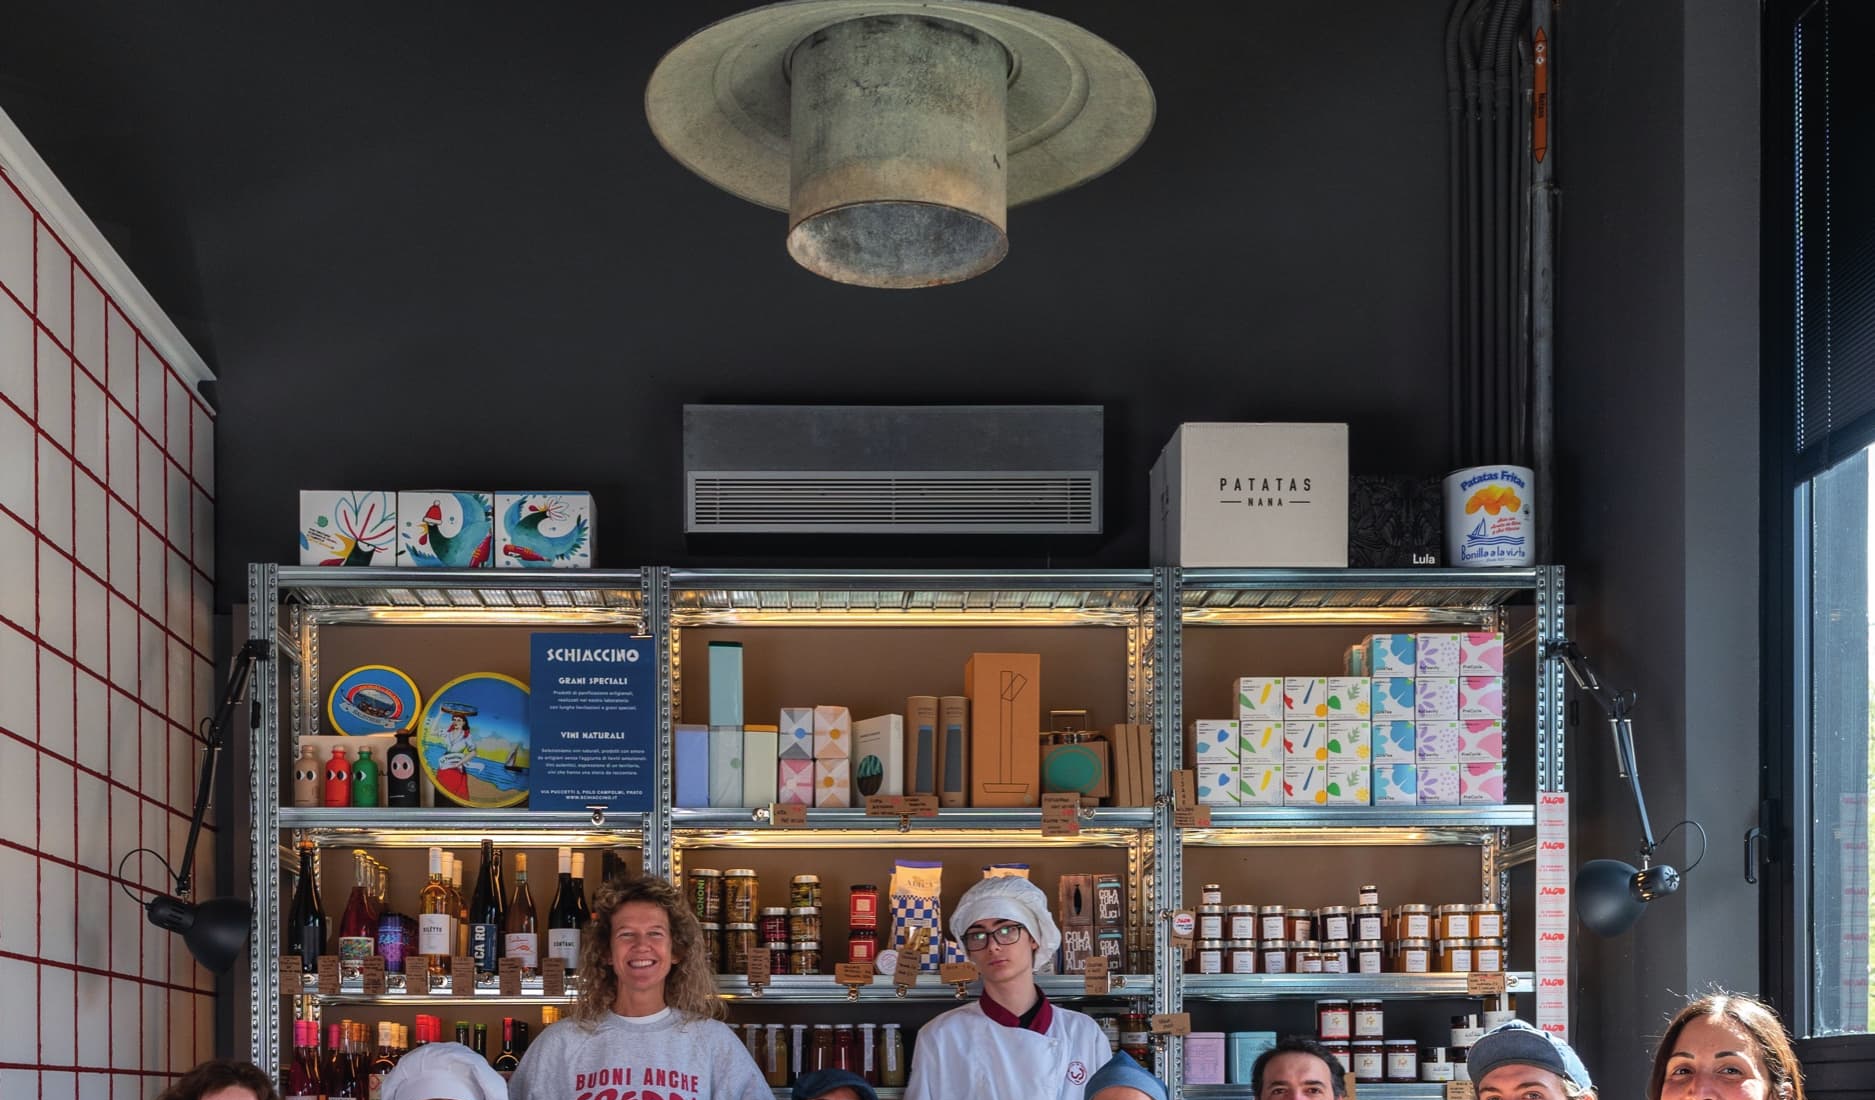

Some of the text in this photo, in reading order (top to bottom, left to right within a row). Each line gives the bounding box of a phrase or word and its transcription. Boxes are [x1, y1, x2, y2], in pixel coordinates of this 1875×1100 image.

[1220, 478, 1311, 492] PATATAS
[1461, 470, 1525, 491] Patatas Fritas
[1248, 498, 1283, 506] NANA
[1462, 544, 1488, 560] Bonilla
[1497, 546, 1504, 556] la
[1507, 547, 1526, 558] vista
[1413, 553, 1436, 564] Lula
[546, 648, 640, 662] SCHIACCINO
[582, 732, 624, 740] NATURALI
[1099, 890, 1117, 898] COLA
[1066, 931, 1090, 940] COLA
[1067, 940, 1091, 951] TURA
[1066, 951, 1075, 960] DI
[576, 1068, 698, 1093] BUONI ANCHE
